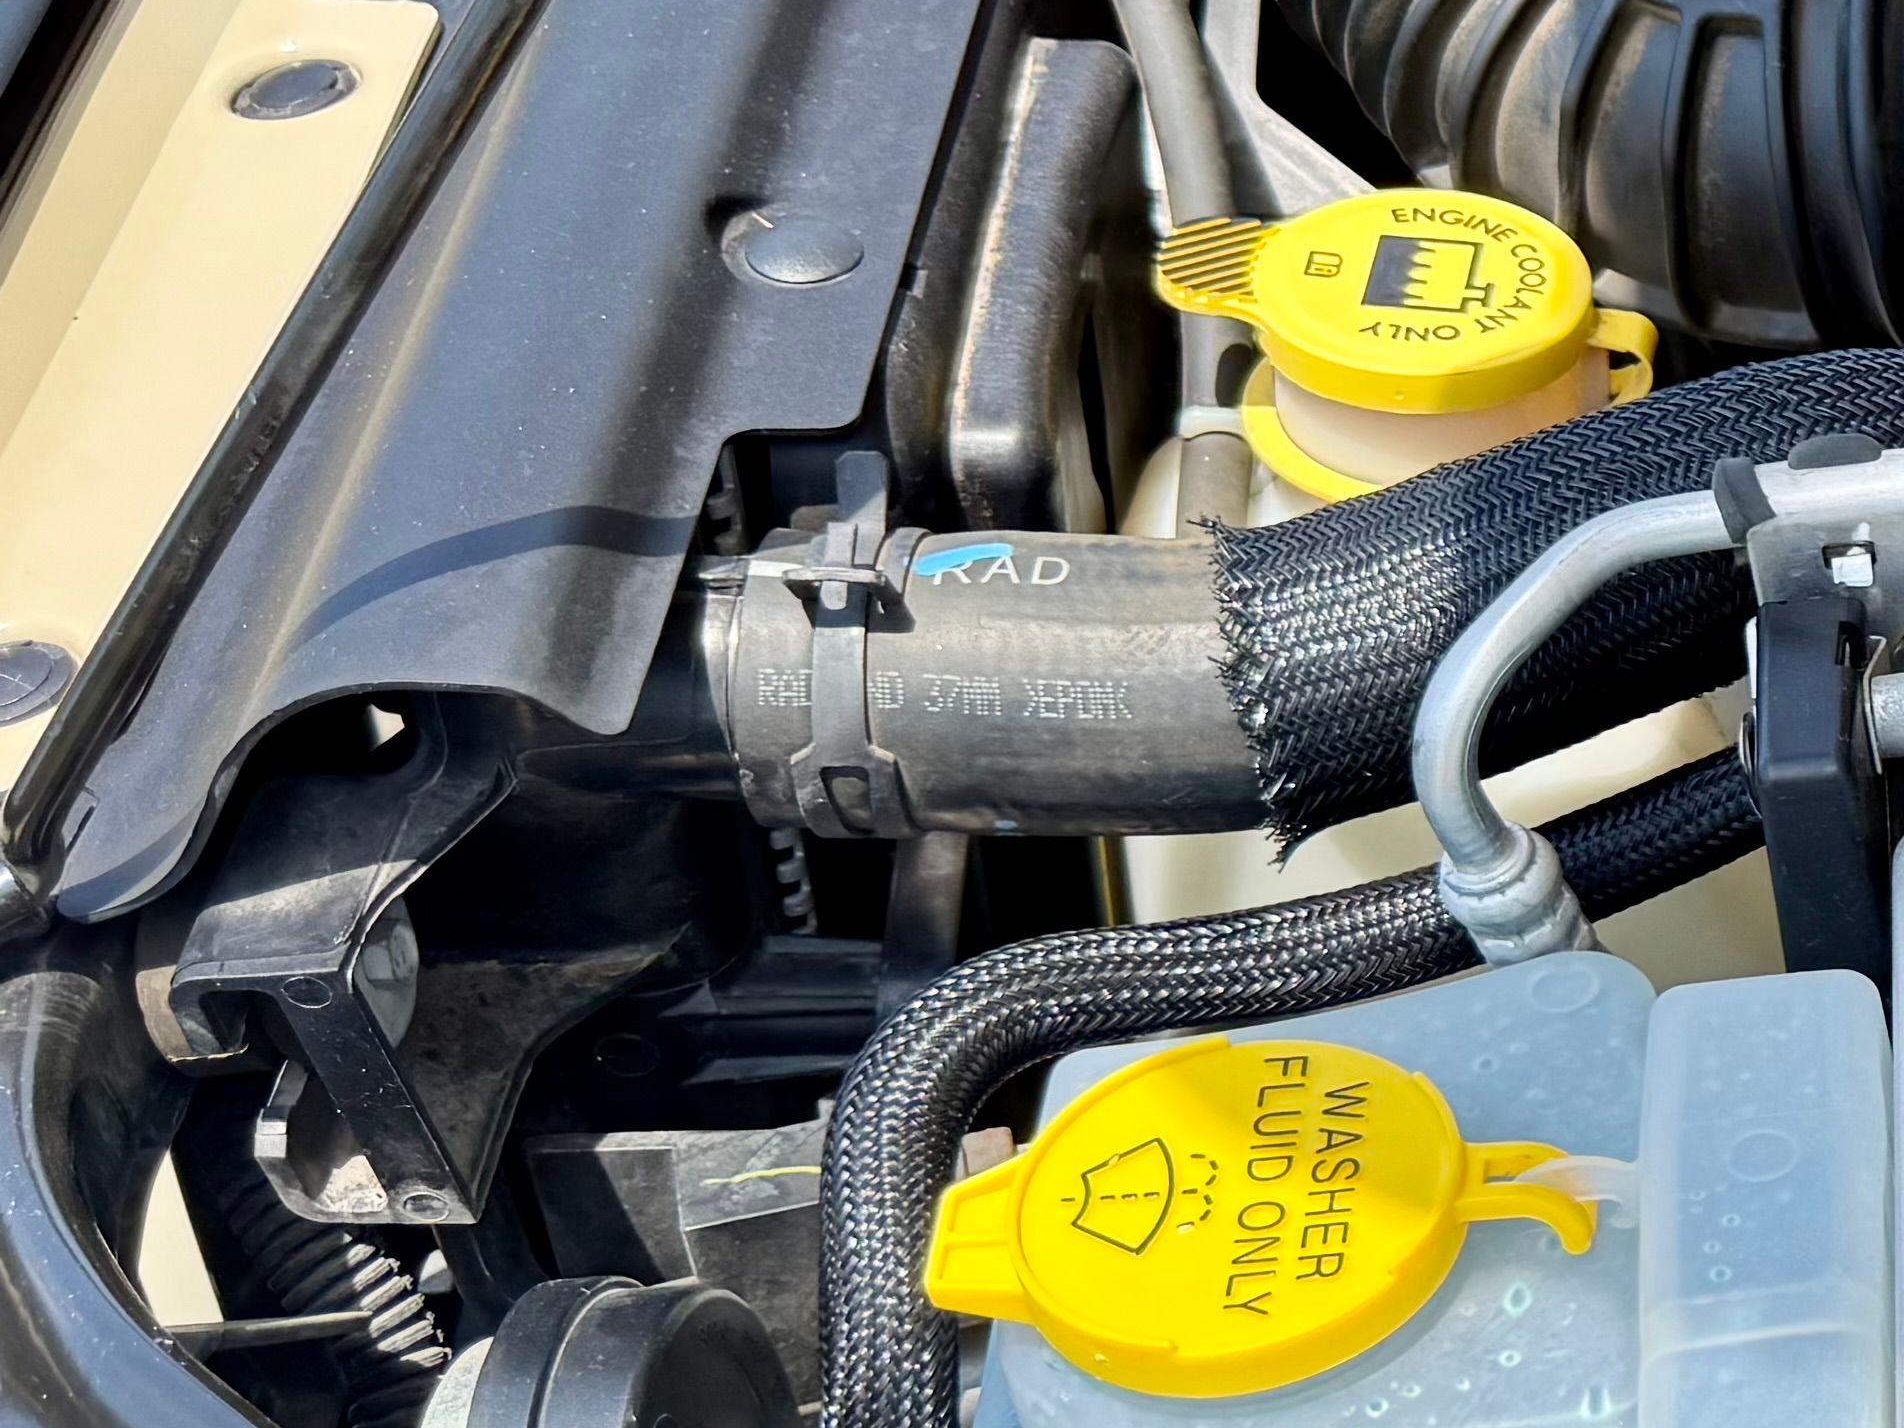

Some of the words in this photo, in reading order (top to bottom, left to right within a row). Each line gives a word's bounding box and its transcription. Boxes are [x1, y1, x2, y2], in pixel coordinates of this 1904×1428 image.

[1391, 207, 1518, 243] ENGINE
[1359, 320, 1462, 342] ONLY
[1476, 243, 1546, 335] COOLANT
[1245, 1054, 1309, 1183] FLUID
[1296, 1080, 1372, 1283] WASHER
[1222, 1199, 1287, 1317] ONLY
